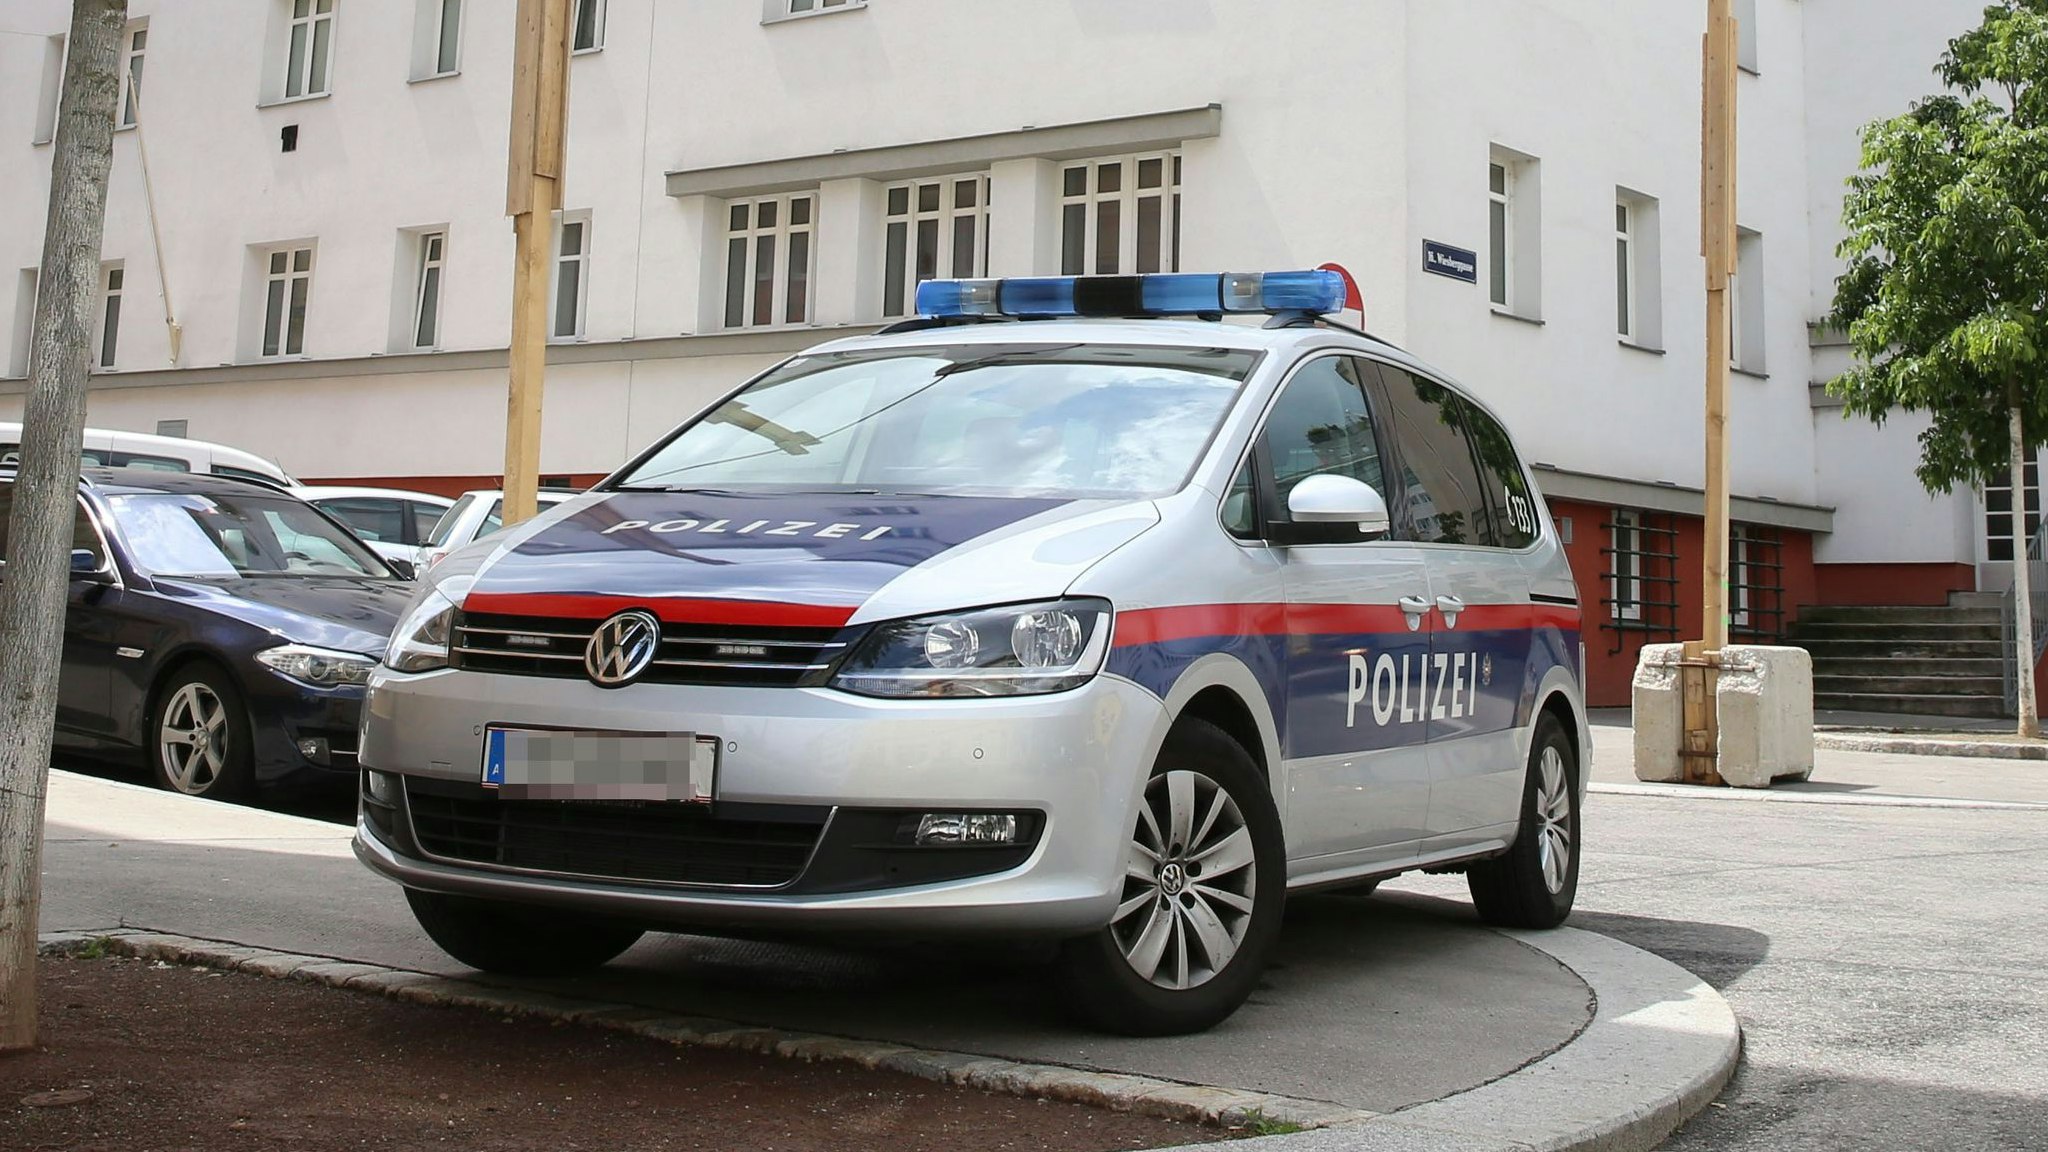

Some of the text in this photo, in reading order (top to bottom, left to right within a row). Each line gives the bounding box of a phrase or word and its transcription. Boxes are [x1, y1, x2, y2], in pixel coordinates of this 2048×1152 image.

[601, 519, 893, 541] POLIZEI
[1511, 495, 1531, 533] 133
[586, 611, 661, 683] VW
[1346, 652, 1477, 728] POLIZEI
[491, 763, 500, 775] A
